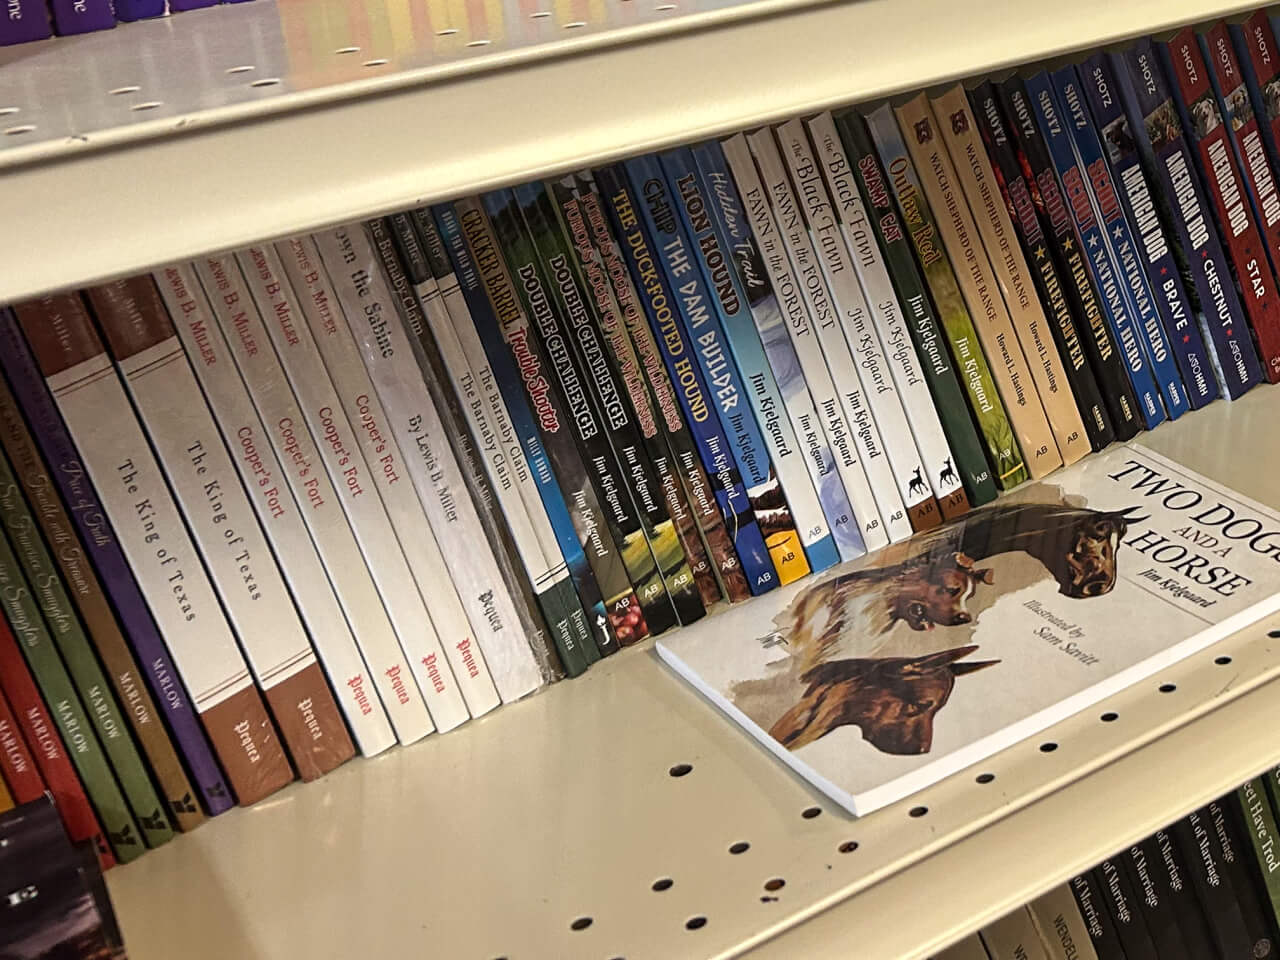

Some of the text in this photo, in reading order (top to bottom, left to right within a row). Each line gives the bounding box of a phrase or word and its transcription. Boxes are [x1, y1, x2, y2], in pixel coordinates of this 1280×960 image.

[1093, 66, 1113, 108] SHOTZ
[1242, 130, 1277, 203] AMERICAN
[676, 173, 741, 317] LION HOUND
[796, 158, 845, 275] Black Fawn
[889, 158, 943, 268] Outlaw Red
[518, 263, 559, 337] DOUBLE
[612, 188, 710, 424] THE DUCK-FOOTED HOUND
[1092, 250, 1143, 373] NATIONAL HERO
[237, 427, 285, 519] Cooper's Fort
[592, 456, 629, 524] Jim Kjelgaard
[1107, 460, 1203, 510] TWO
[117, 459, 196, 622] The King of Texas
[1124, 530, 1253, 596] HORSE
[1172, 527, 1232, 558] AND A
[1137, 568, 1217, 608] Jim Kjelgaard
[152, 658, 183, 711] MARLOW
[234, 720, 261, 763] Pequea
